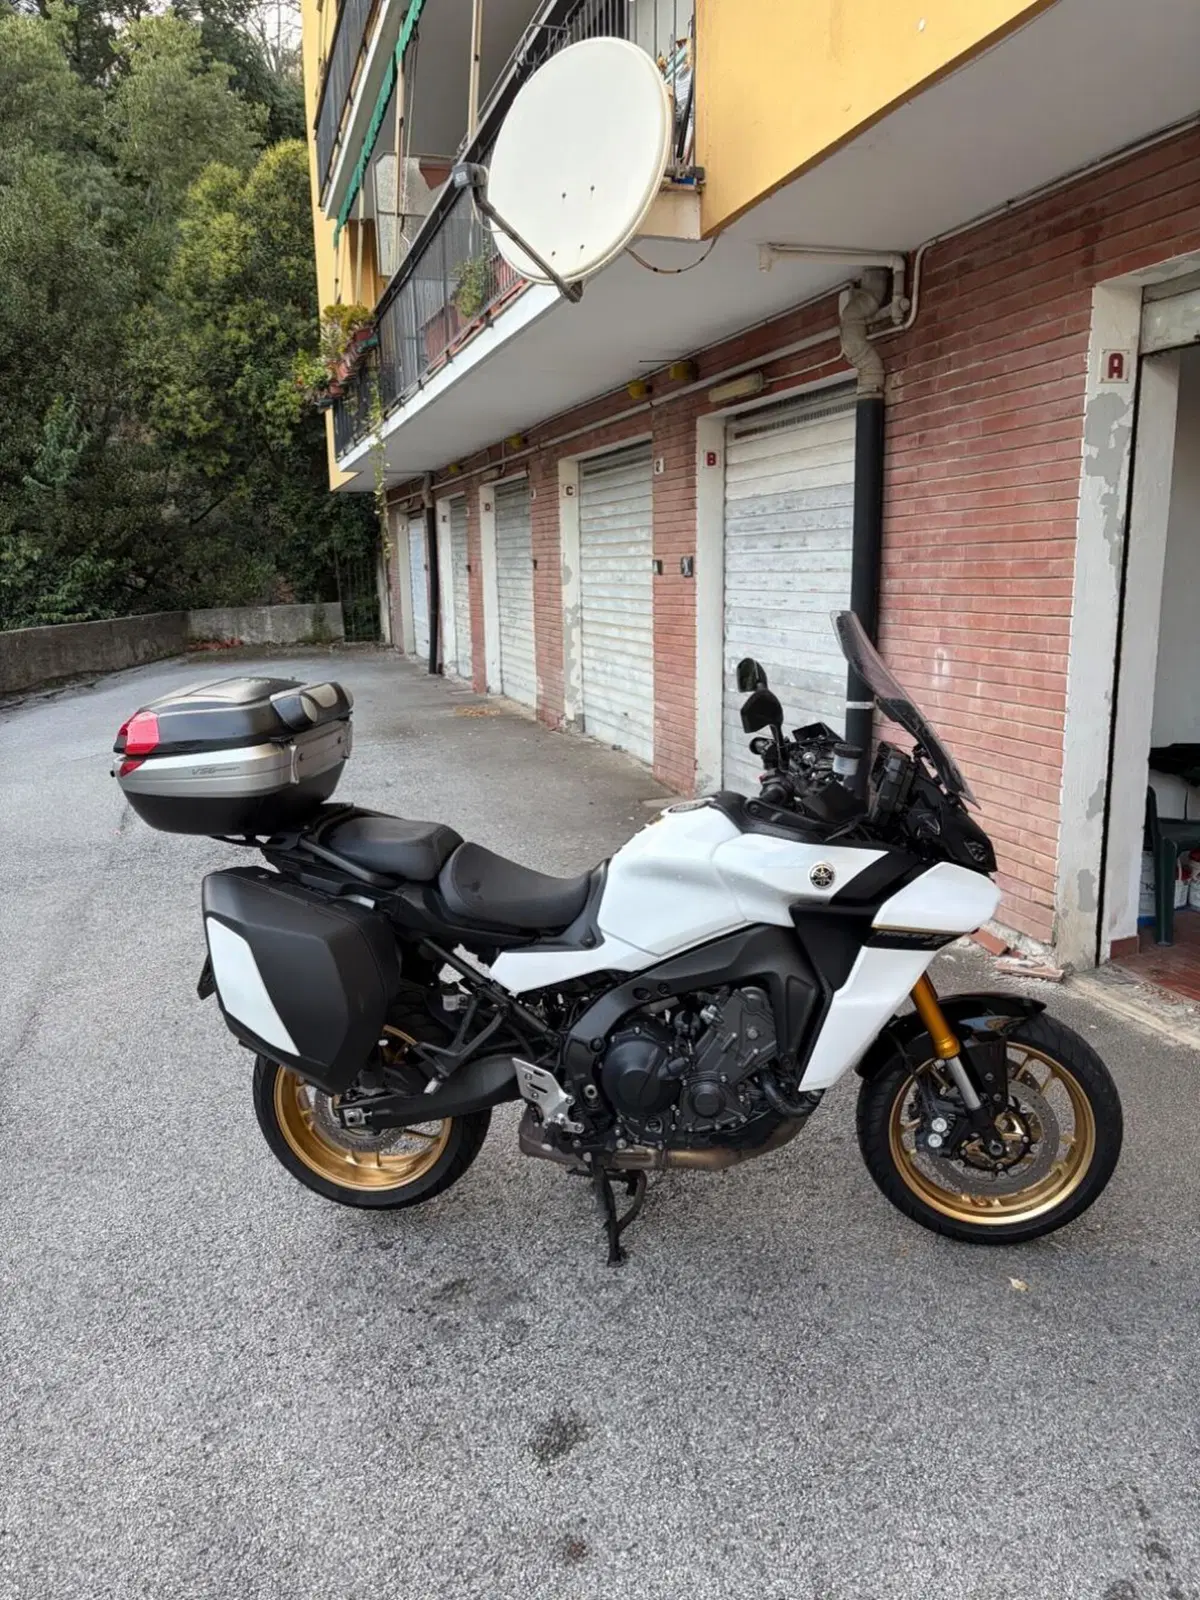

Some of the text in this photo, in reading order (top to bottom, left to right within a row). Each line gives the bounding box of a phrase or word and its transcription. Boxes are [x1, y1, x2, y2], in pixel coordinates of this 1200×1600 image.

[1107, 353, 1124, 379] A
[706, 452, 717, 466] B
[565, 485, 574, 496] C
